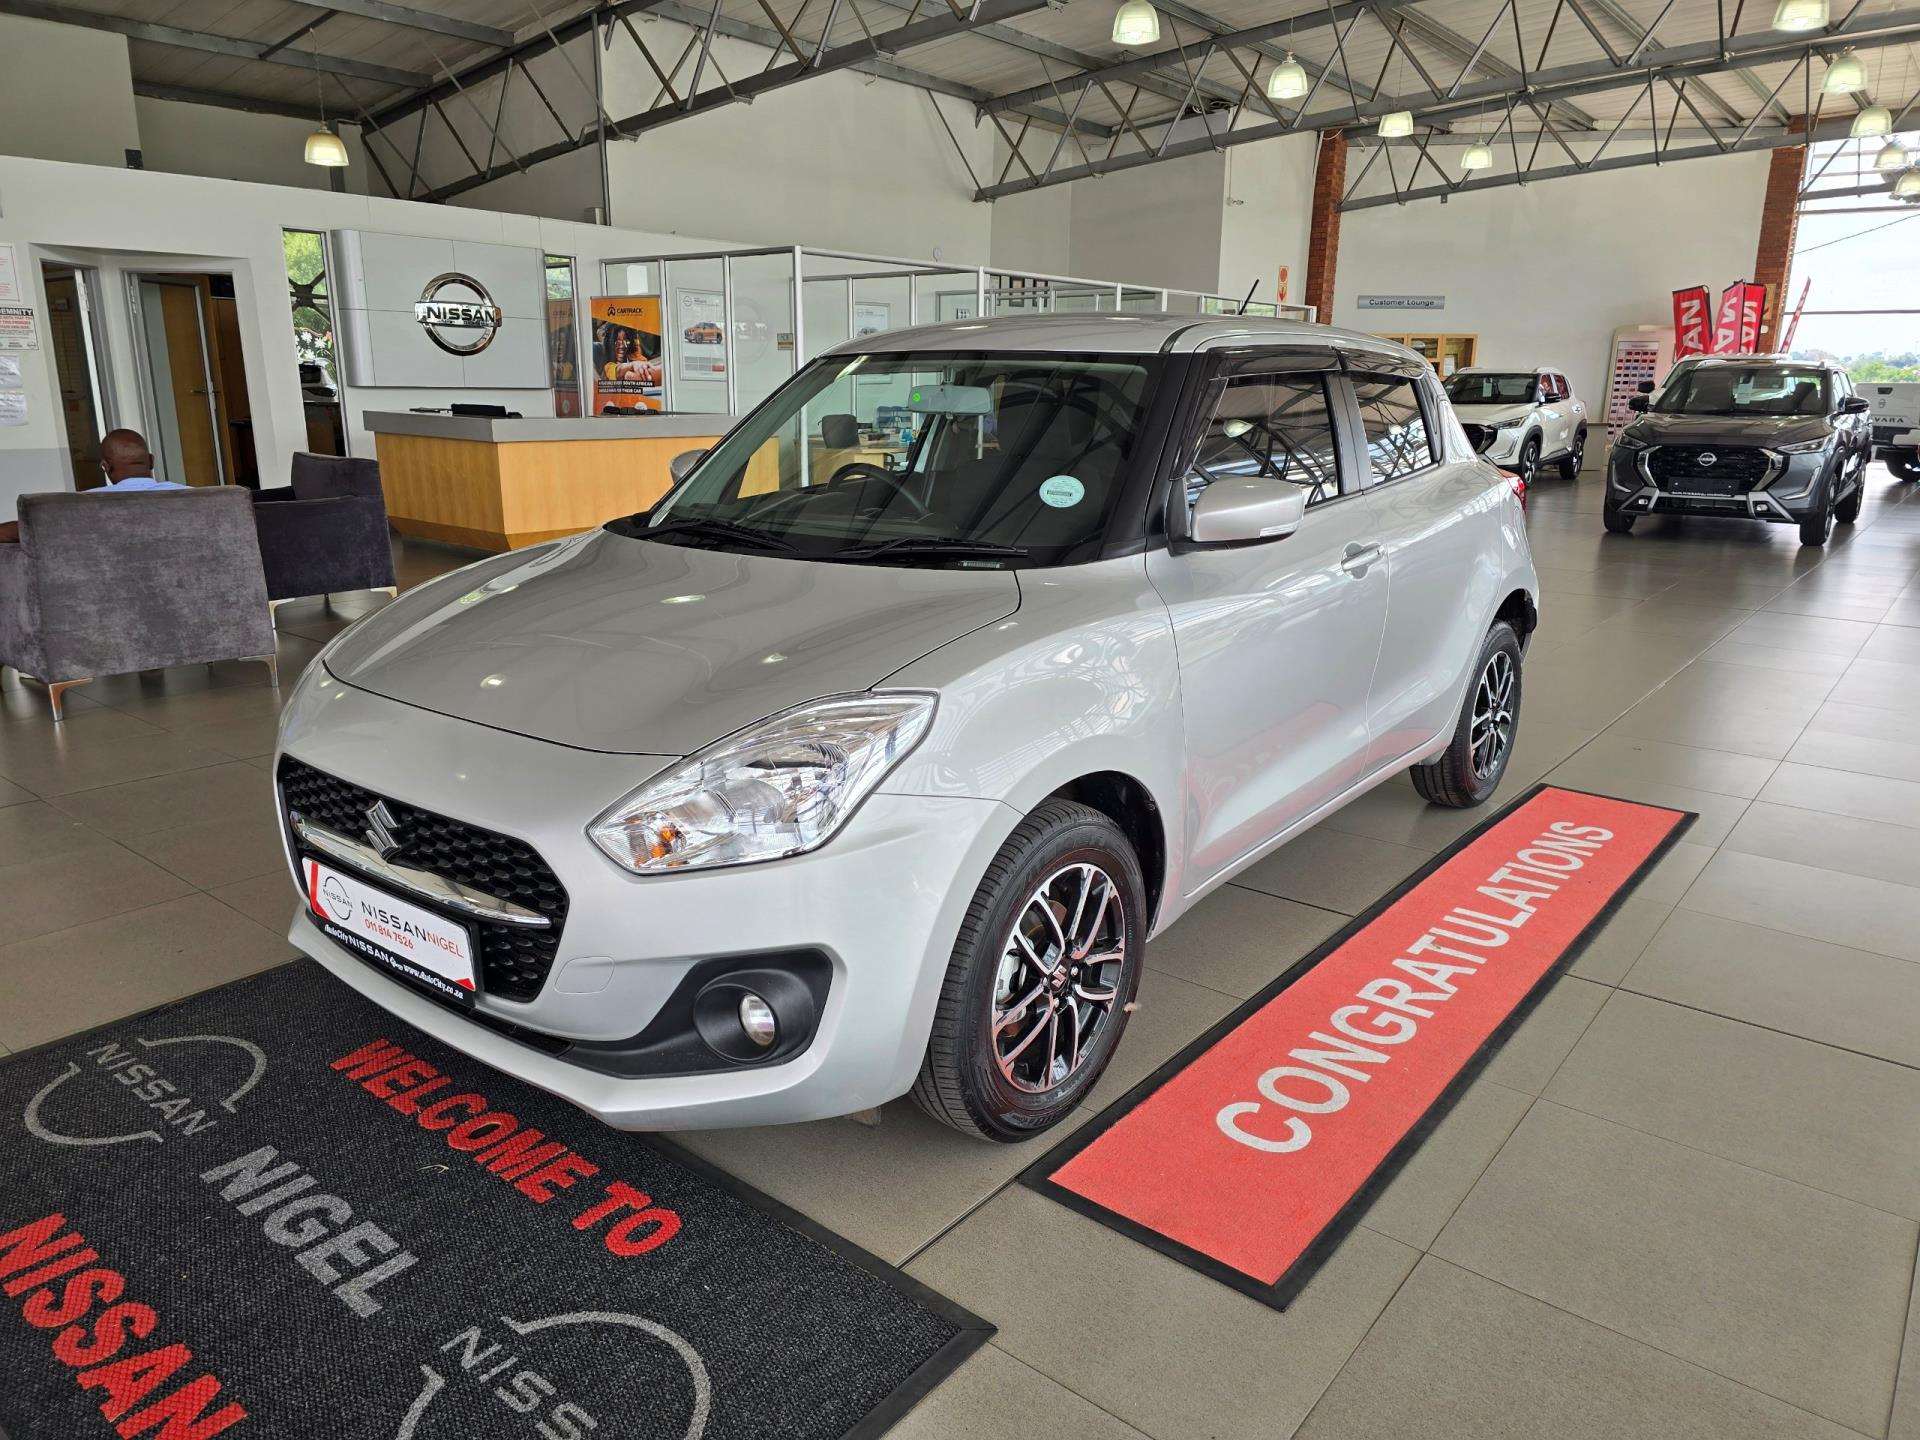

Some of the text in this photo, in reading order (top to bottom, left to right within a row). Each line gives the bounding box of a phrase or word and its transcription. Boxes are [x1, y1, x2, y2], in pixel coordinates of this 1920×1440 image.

[0, 308, 33, 316] EMNITY
[426, 306, 495, 322] NISSAN
[1368, 298, 1435, 307] Customer Lounge
[323, 889, 353, 908] NISSAN
[324, 924, 349, 944] AutoCity
[349, 935, 389, 963] NISSAN
[364, 918, 414, 949] 011 814 7526
[1215, 820, 1615, 1154] CONGRATULATIONS
[86, 1042, 217, 1136] NISSAN
[330, 1038, 683, 1257] WELCOME TO
[200, 1144, 420, 1319] NIGEL
[0, 1211, 249, 1440] NISSAN
